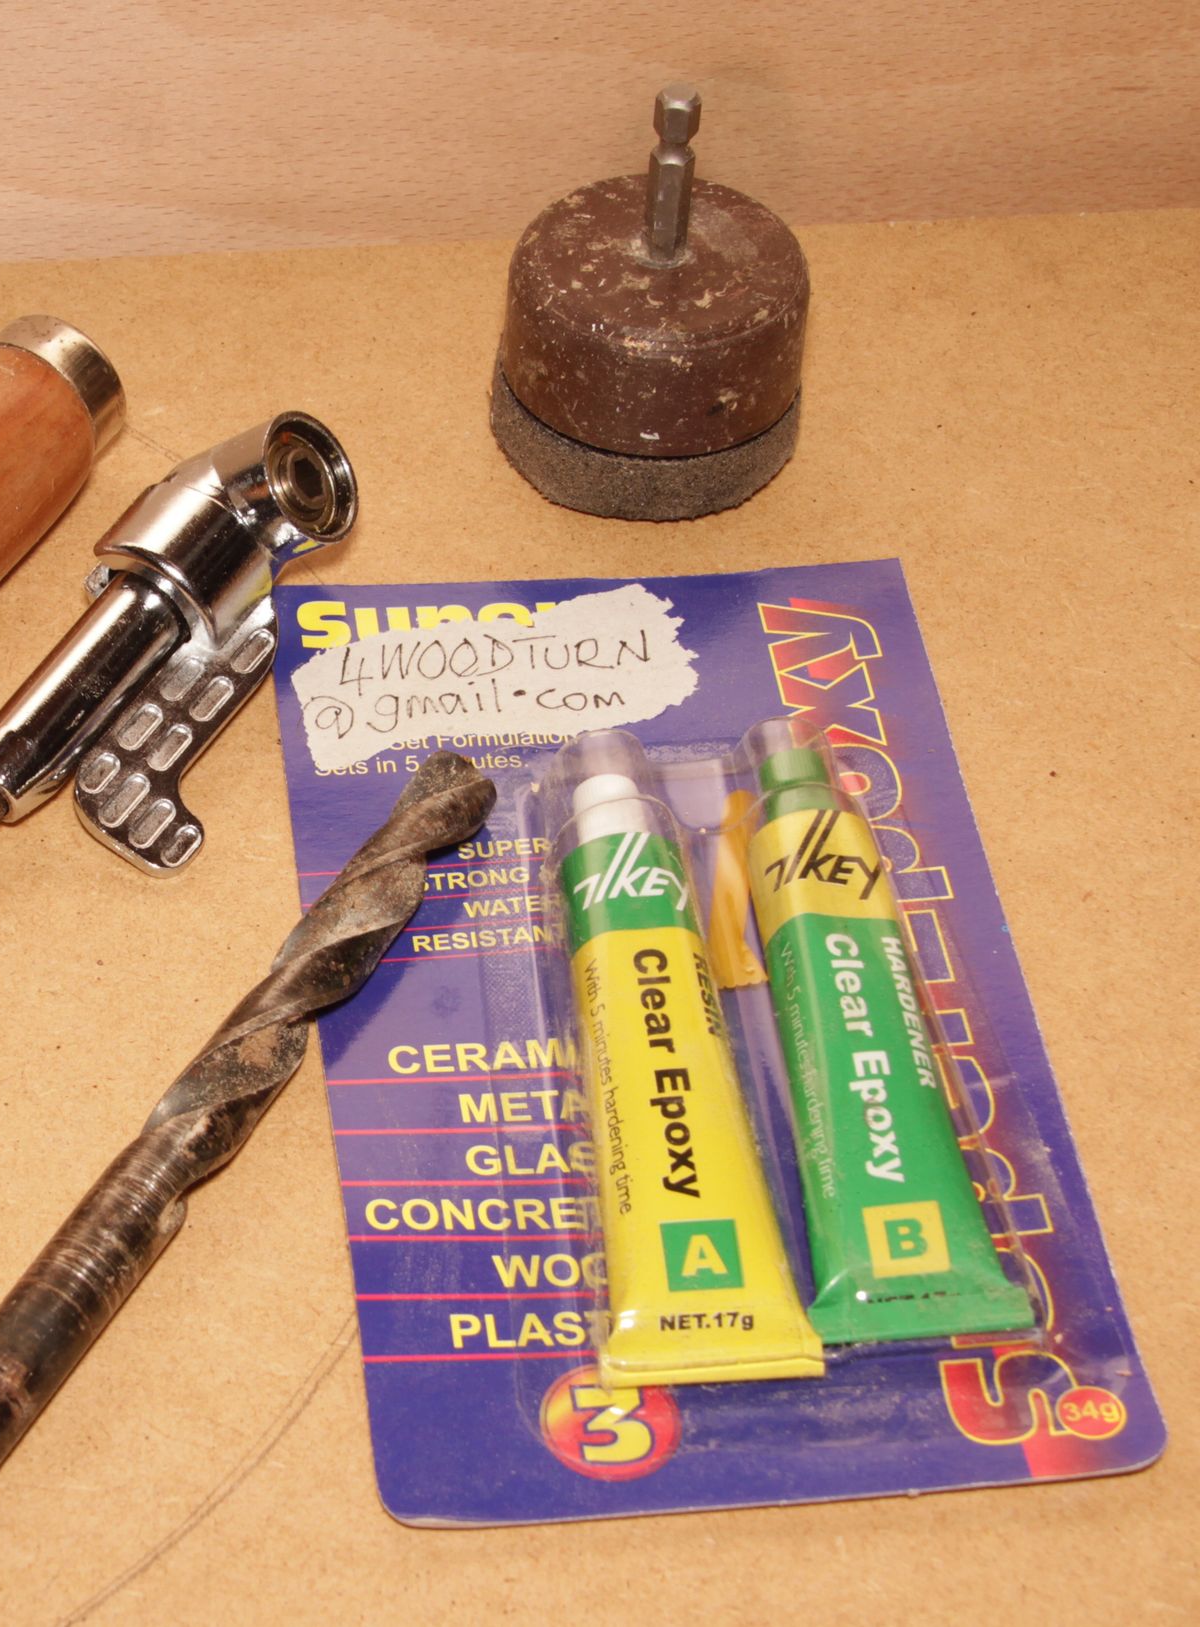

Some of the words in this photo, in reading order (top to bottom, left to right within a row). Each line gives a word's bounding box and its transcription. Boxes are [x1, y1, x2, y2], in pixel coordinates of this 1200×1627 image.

[376, 757, 398, 774] in
[405, 755, 420, 772] 5
[458, 837, 550, 860] SUPER
[585, 958, 601, 1003] With
[633, 948, 676, 1054] Clear
[787, 986, 801, 1001] 5
[590, 1003, 606, 1018] 5
[881, 936, 937, 1089] HARDENER
[591, 1018, 613, 1086] minutes
[825, 933, 873, 1038] Clear
[849, 1051, 905, 1183] Epoxy
[458, 1090, 590, 1124] META
[603, 1086, 630, 1174] hardening
[650, 1068, 701, 1198] Epoxy
[614, 1172, 633, 1215] time
[681, 1234, 729, 1277] A
[883, 1218, 929, 1261] B
[491, 1252, 607, 1288] WOO
[570, 1384, 655, 1464] 3
[1061, 1397, 1121, 1424] 34g
